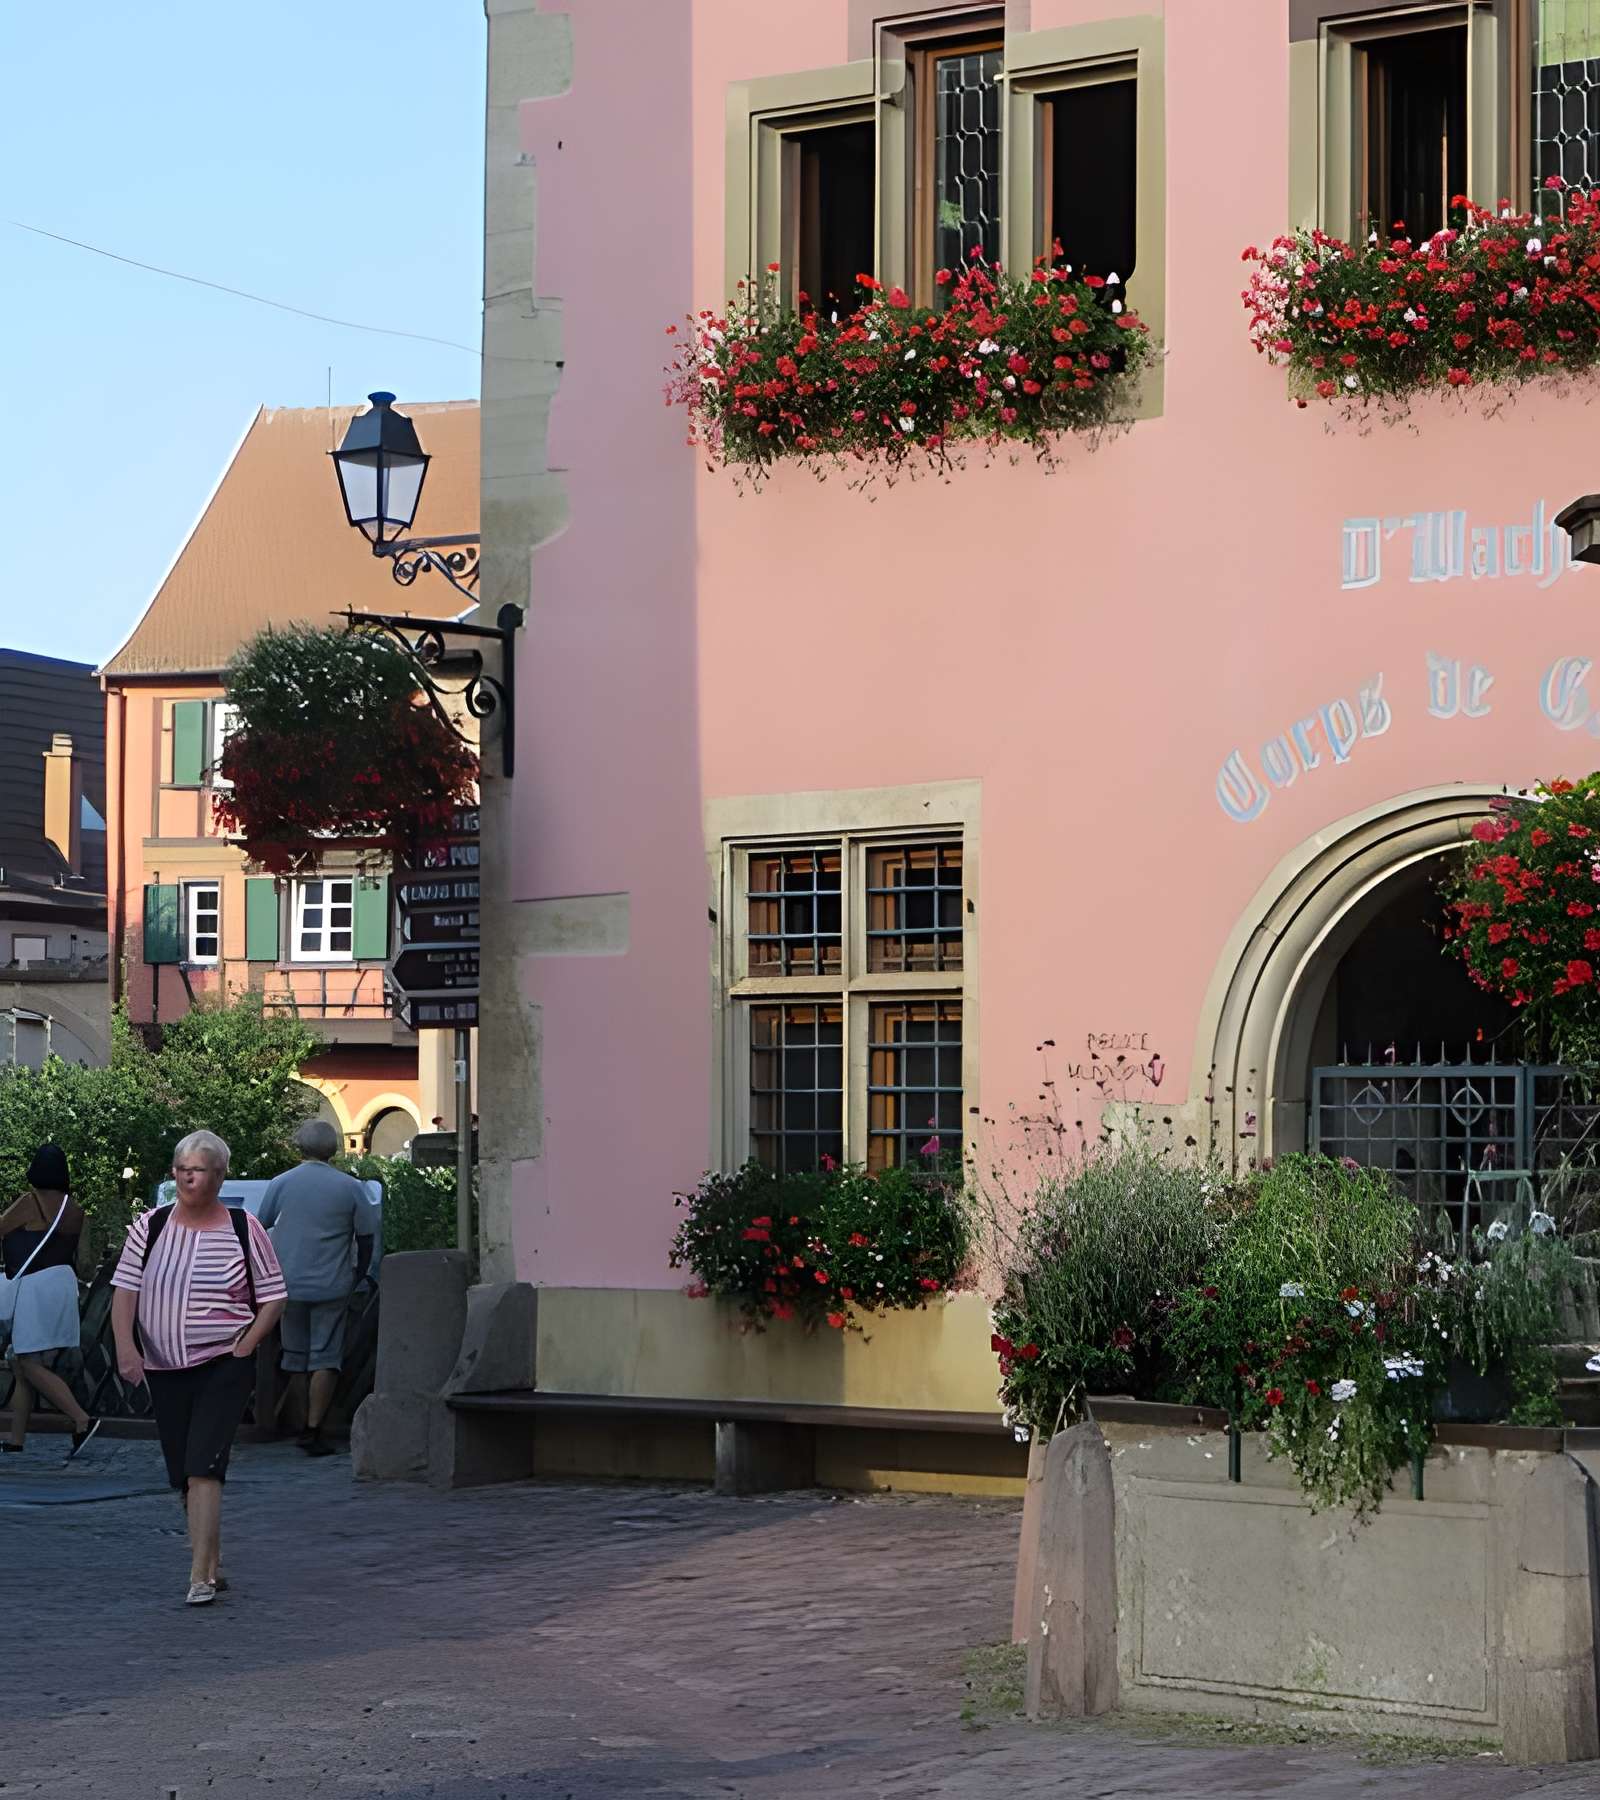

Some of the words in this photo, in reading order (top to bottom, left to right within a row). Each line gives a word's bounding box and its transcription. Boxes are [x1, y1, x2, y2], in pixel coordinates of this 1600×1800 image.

[1341, 497, 1584, 588] D'Wach
[1216, 672, 1391, 823] Corps
[1426, 651, 1494, 719] de
